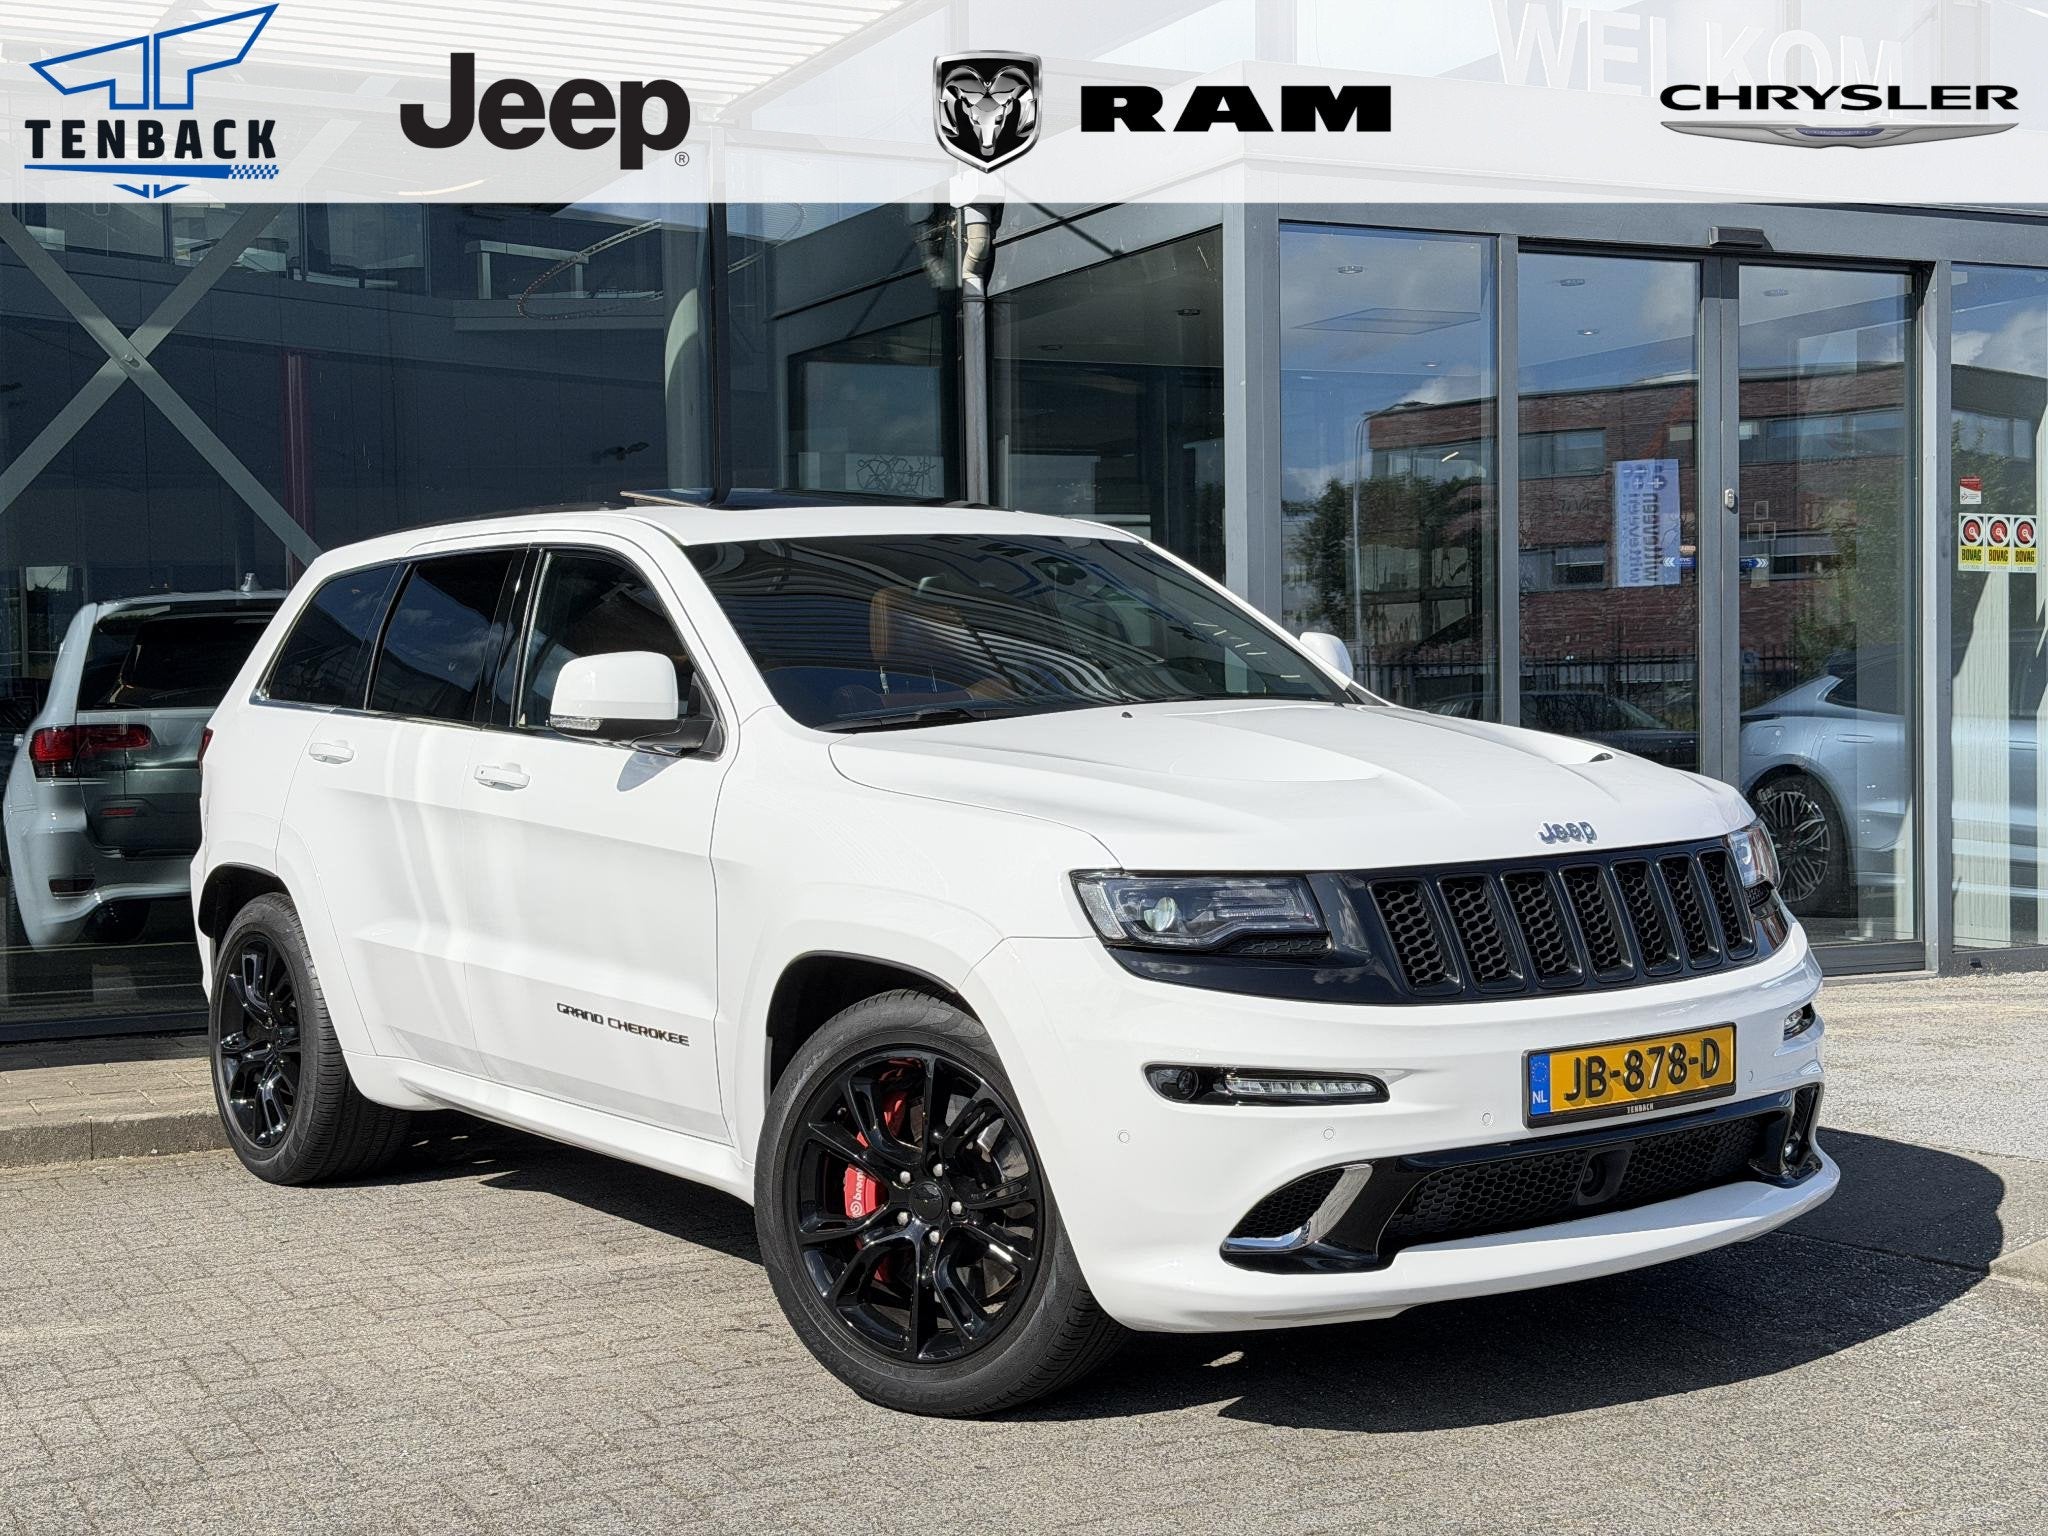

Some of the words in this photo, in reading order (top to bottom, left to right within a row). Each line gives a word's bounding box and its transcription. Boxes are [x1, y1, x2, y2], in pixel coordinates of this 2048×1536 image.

[1961, 549, 1982, 561] BOVAG
[1988, 549, 2009, 562] BOVAG
[2015, 550, 2035, 562] BOVAG
[1537, 821, 1598, 844] Jeep
[556, 1002, 604, 1025] GRAND
[607, 1017, 690, 1047] CHEROKEE
[1563, 1037, 1720, 1101] JB-878-D
[1532, 1090, 1548, 1104] NL
[1626, 1102, 1654, 1114] TENBACK
